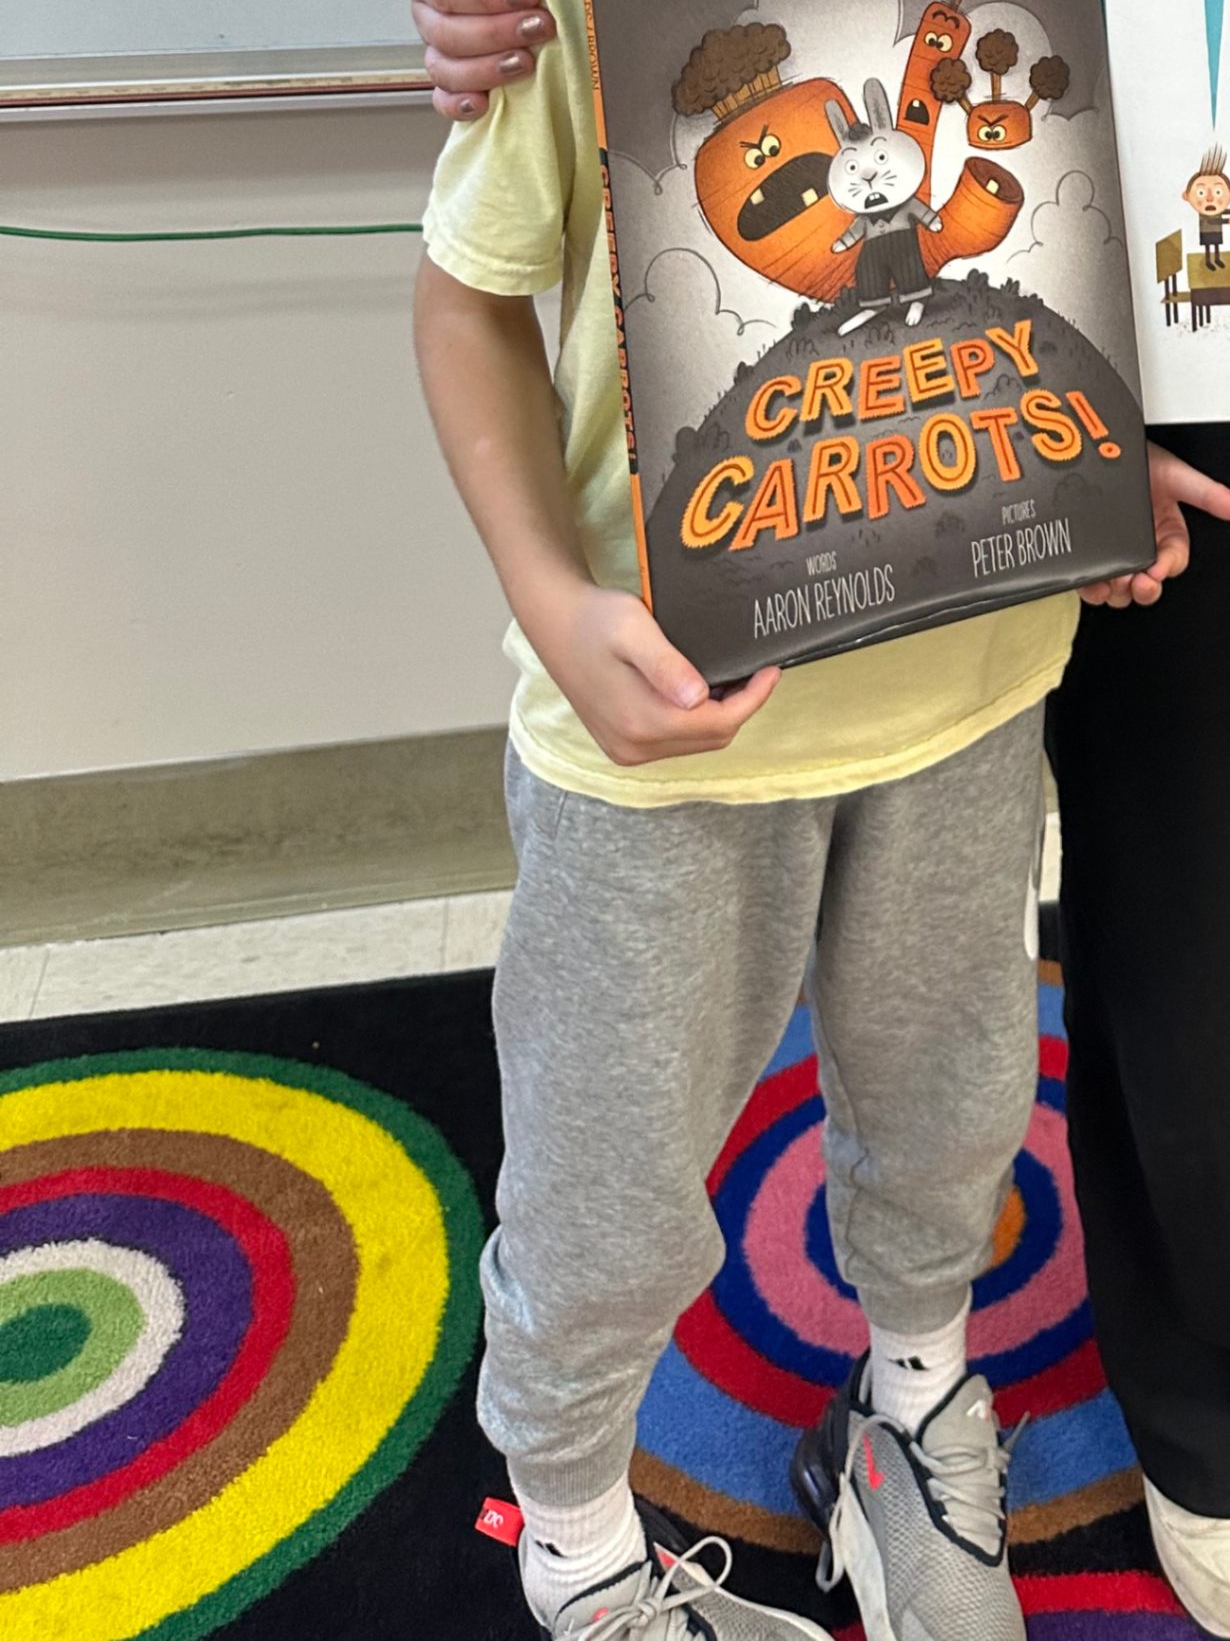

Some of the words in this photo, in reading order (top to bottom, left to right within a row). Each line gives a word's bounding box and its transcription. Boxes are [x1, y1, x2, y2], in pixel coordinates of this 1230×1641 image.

[744, 319, 1040, 442] CREEPY
[680, 388, 1122, 552] CARROTS!
[1001, 498, 1037, 526] PICTURES
[806, 551, 838, 578] WORDS
[970, 535, 1015, 579] PETER
[1015, 517, 1073, 567] BROWN
[753, 585, 812, 640] AARON
[813, 564, 897, 621] REYNOLDS
